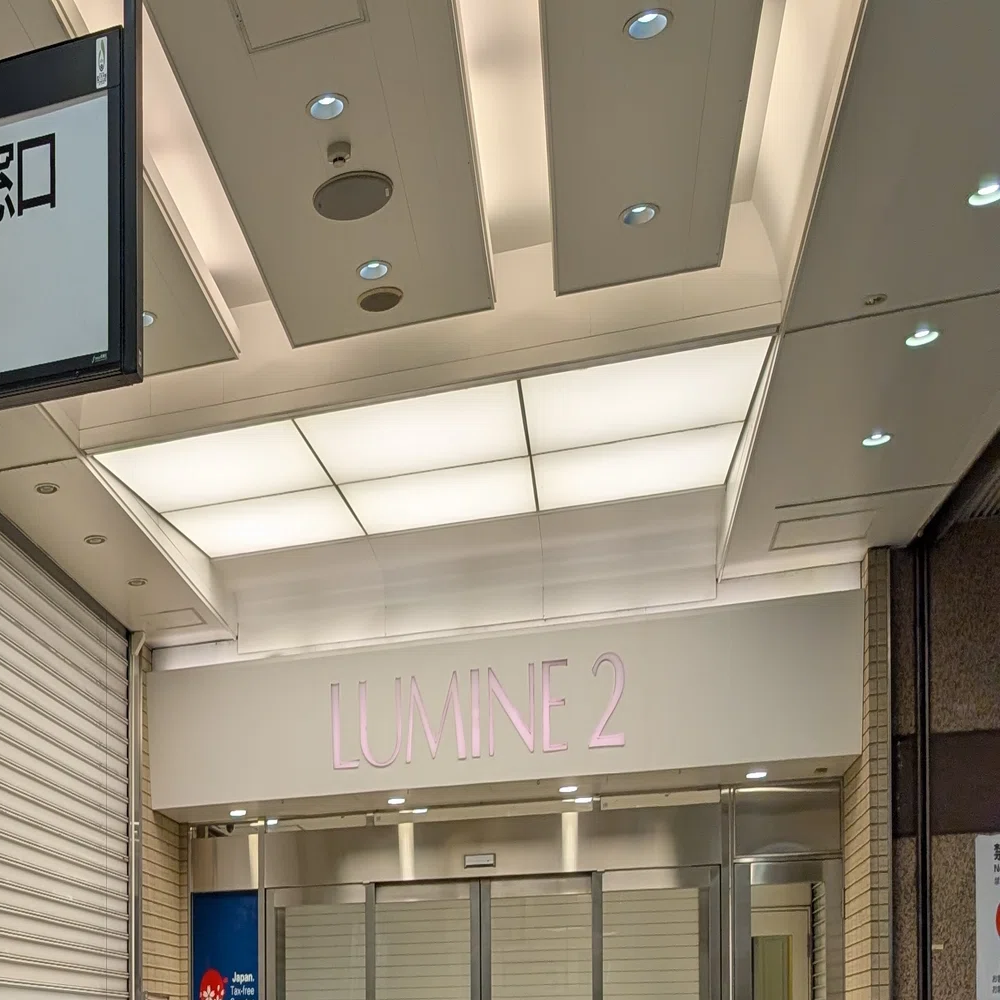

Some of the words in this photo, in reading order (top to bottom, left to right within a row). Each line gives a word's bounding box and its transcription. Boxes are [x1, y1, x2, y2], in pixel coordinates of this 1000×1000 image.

[330, 659, 568, 769] LUMINE
[588, 652, 625, 748] 2
[231, 986, 255, 996] Tax-free
